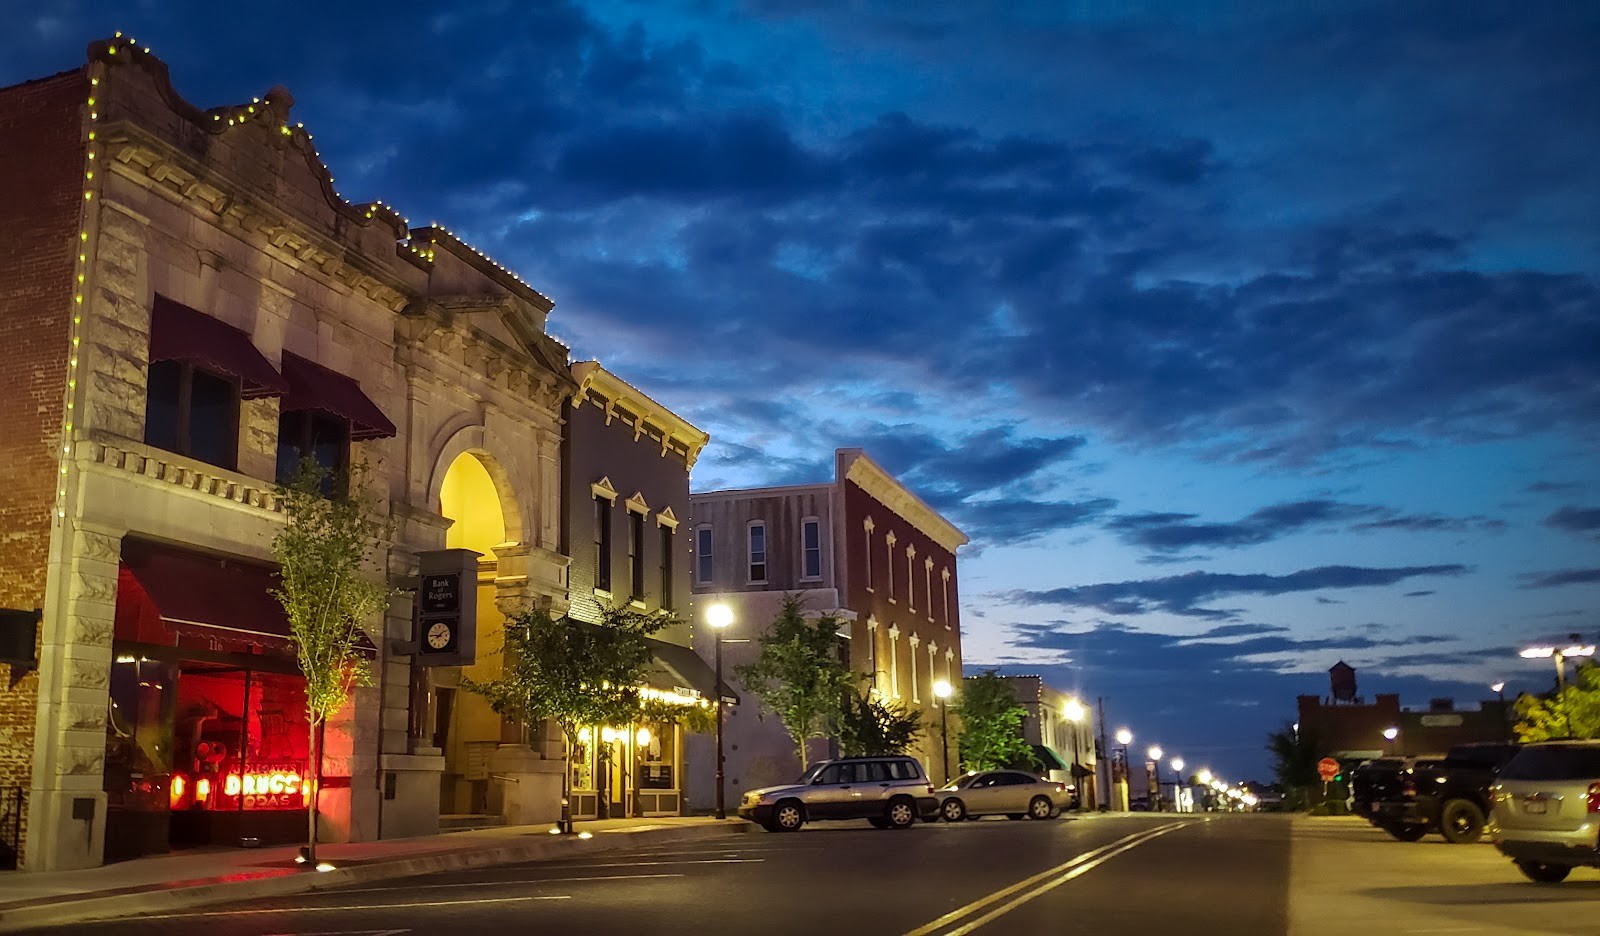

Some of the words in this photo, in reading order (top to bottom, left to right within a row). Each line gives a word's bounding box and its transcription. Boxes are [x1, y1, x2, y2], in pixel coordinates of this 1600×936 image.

[432, 579, 450, 588] Bank
[428, 591, 453, 601] Rogers
[209, 640, 223, 652] 116
[224, 774, 301, 795] DRUGS
